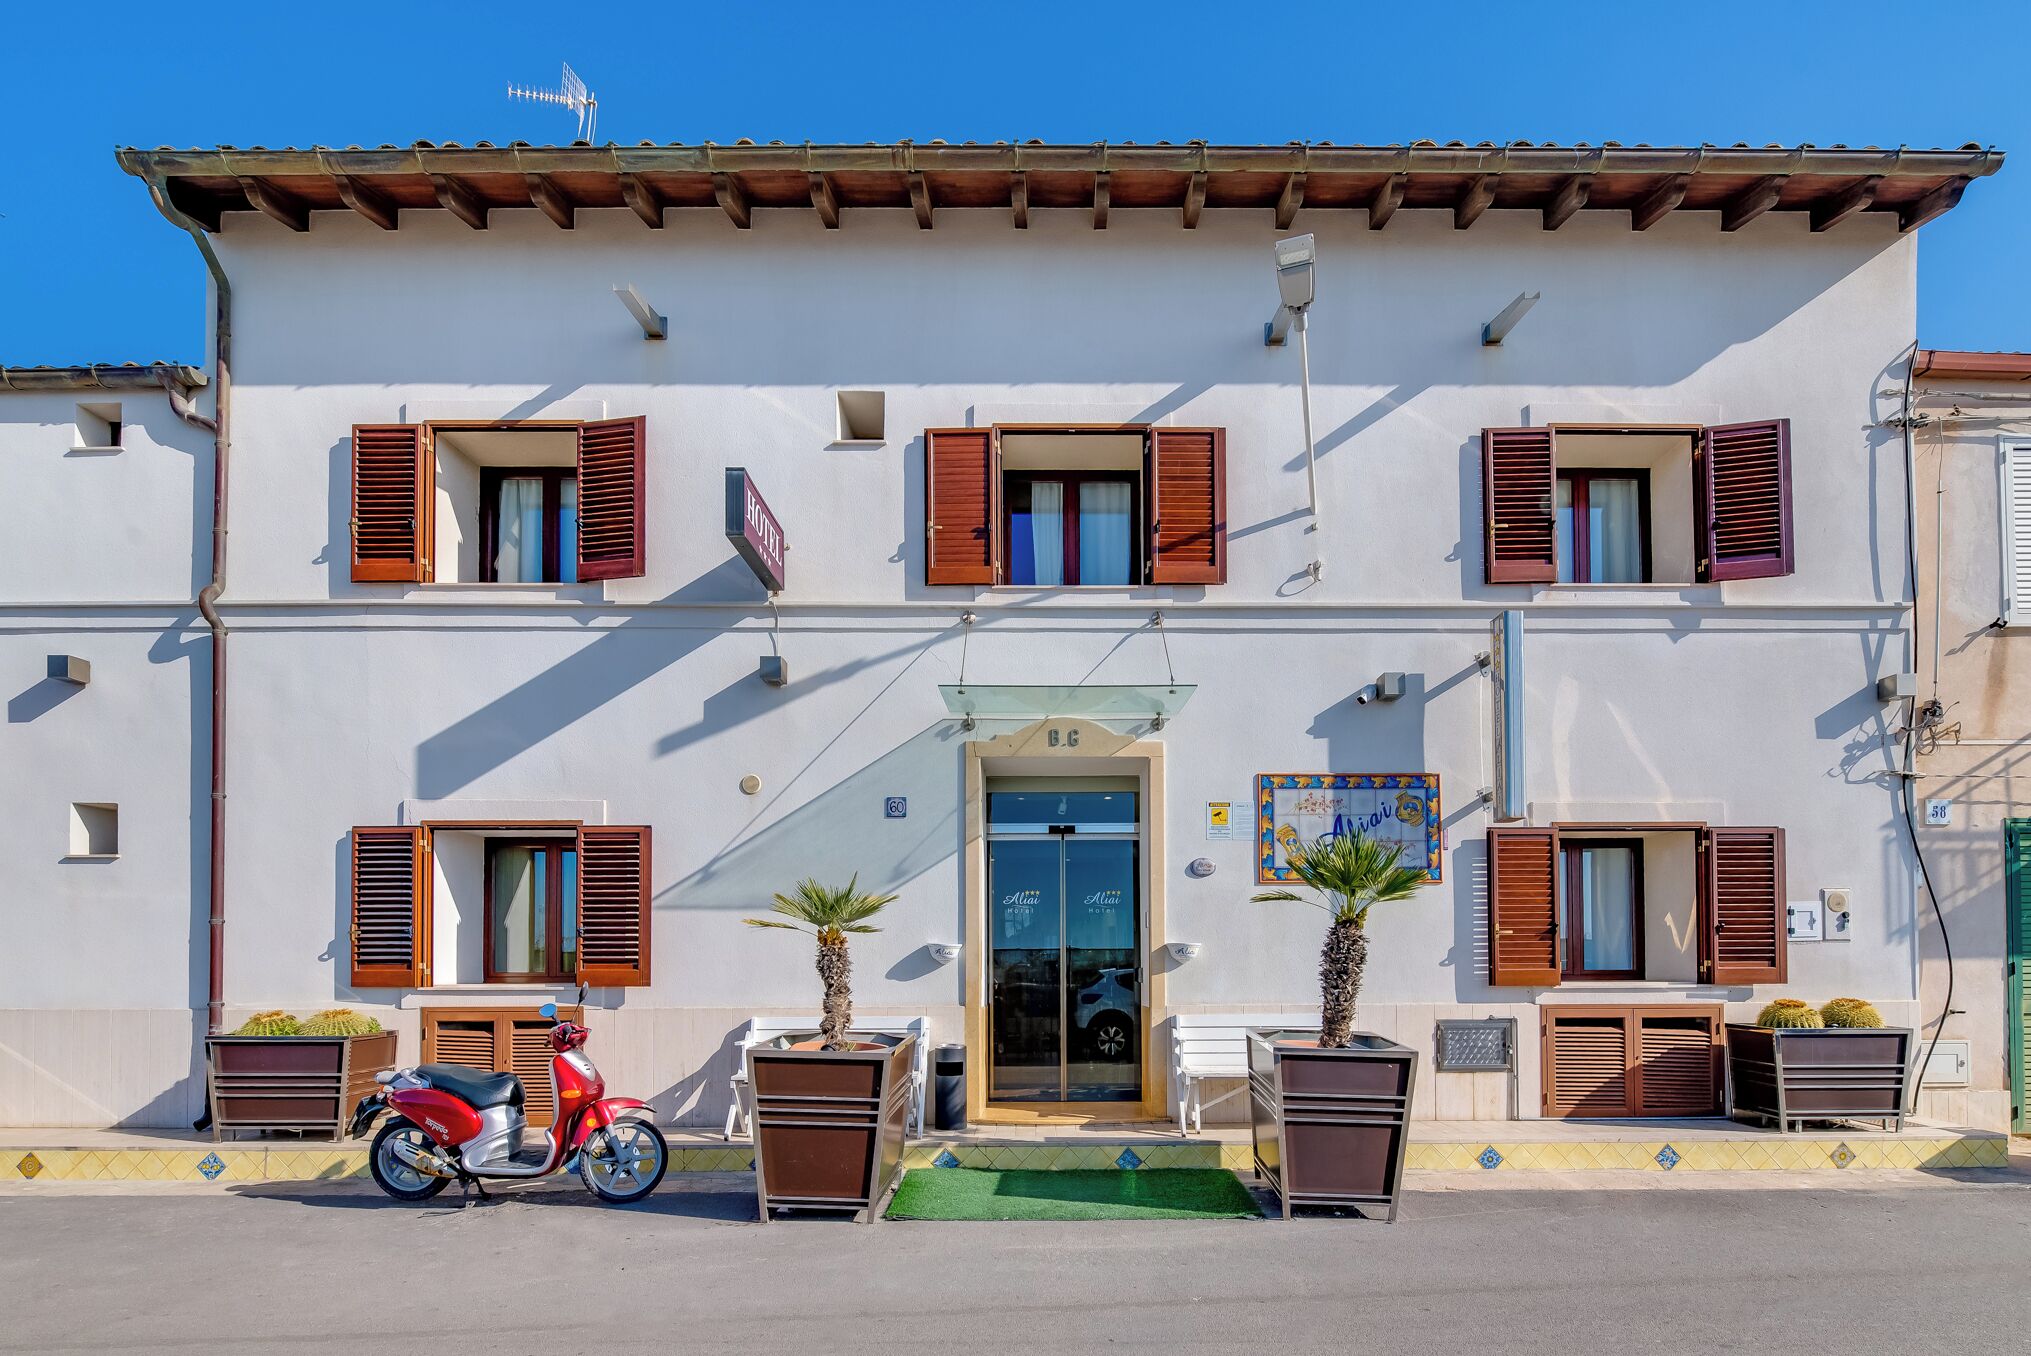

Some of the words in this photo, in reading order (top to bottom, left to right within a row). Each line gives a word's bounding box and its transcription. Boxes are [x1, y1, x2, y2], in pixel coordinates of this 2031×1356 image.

[746, 487, 783, 568] HOTEL
[889, 800, 905, 813] 60
[1931, 805, 1947, 819] 58
[1003, 891, 1041, 905] Aliai
[1083, 891, 1121, 905] Aliai
